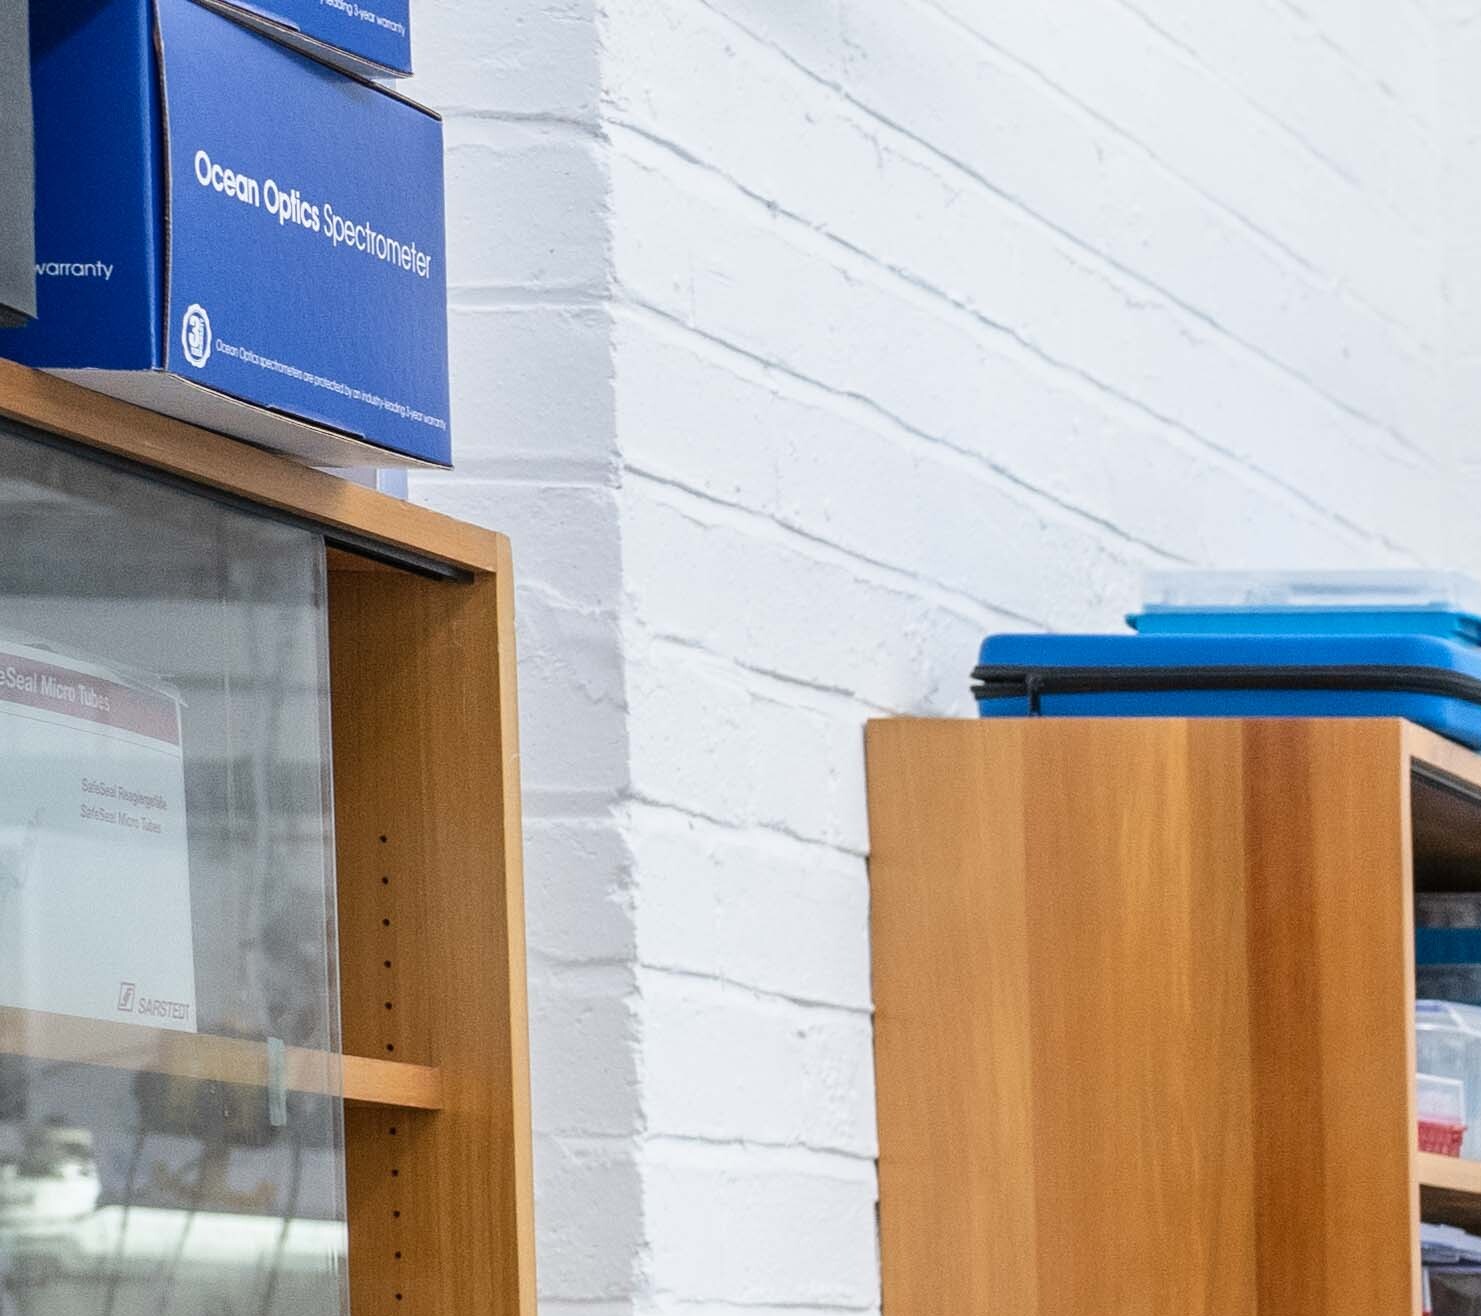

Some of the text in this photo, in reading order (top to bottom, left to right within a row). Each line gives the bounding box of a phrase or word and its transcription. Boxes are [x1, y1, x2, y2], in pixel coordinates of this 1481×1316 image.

[194, 150, 432, 279] Ocean Optics Spectrometer
[41, 674, 76, 702] Micro
[138, 998, 190, 1021] SARSTEDT
